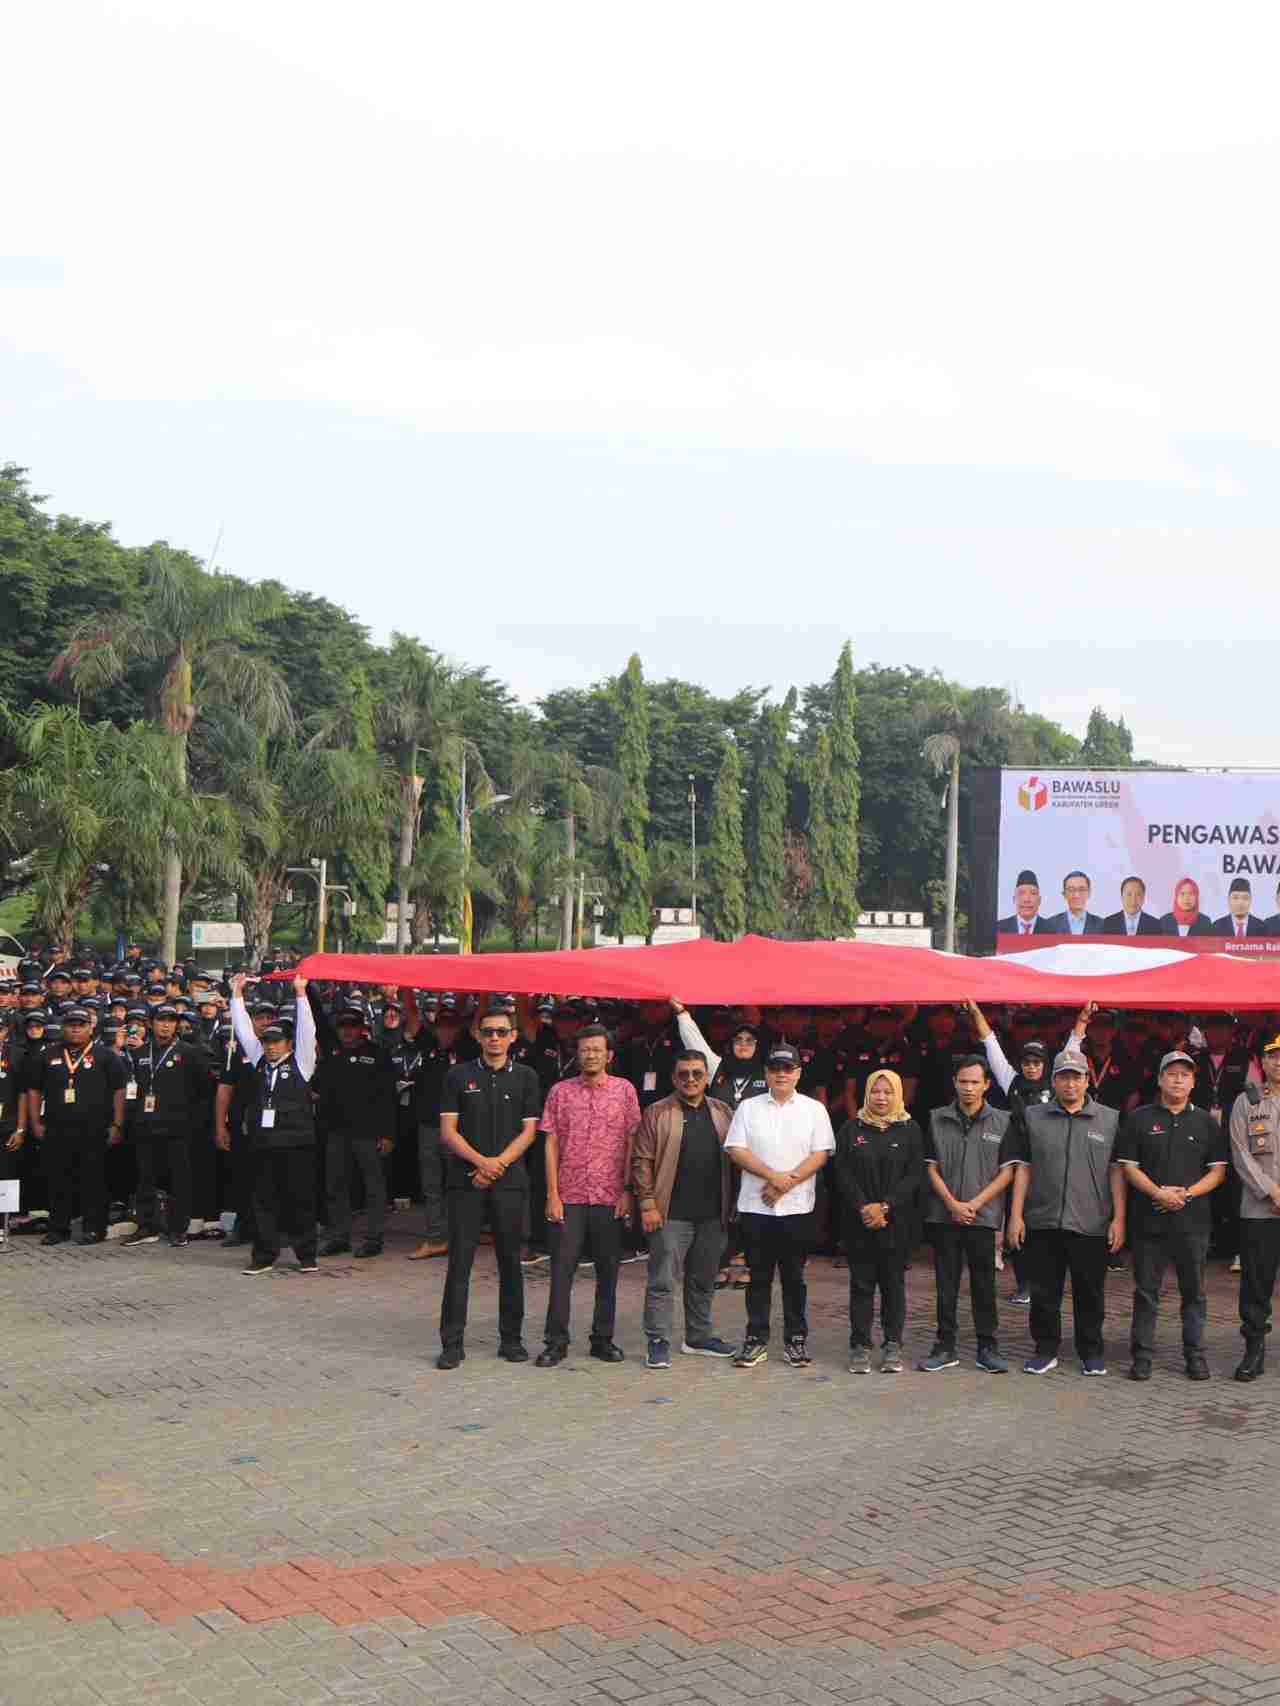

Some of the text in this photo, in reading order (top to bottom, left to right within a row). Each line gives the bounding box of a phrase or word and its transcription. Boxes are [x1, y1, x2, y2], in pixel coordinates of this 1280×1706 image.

[1052, 780, 1121, 794] BAWASLU
[1148, 824, 1280, 846] PENGAWAS
[1225, 942, 1264, 951] Bersama
